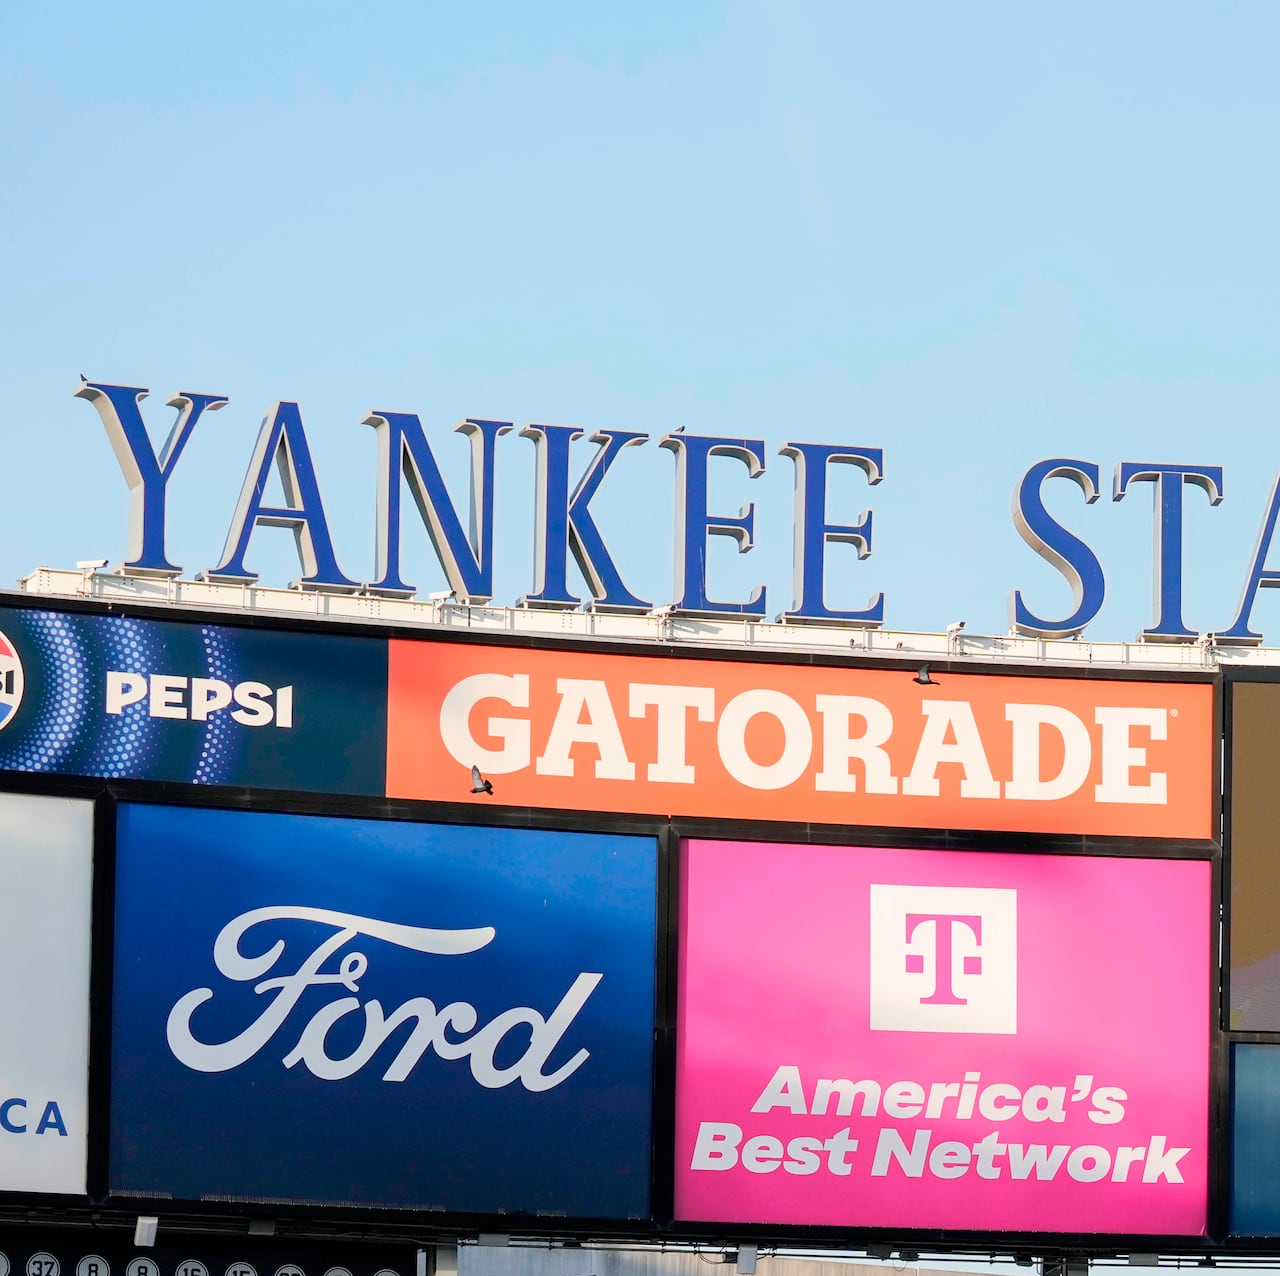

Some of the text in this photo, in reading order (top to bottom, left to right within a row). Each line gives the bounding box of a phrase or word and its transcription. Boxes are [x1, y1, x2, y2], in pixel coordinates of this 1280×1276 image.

[74, 382, 885, 628] YANKEE
[106, 671, 293, 729] PEPSI
[439, 673, 1168, 805] GATORADE
[167, 906, 603, 1092] Ford
[749, 1065, 1129, 1125] America's
[691, 1122, 1192, 1184] Best Network
